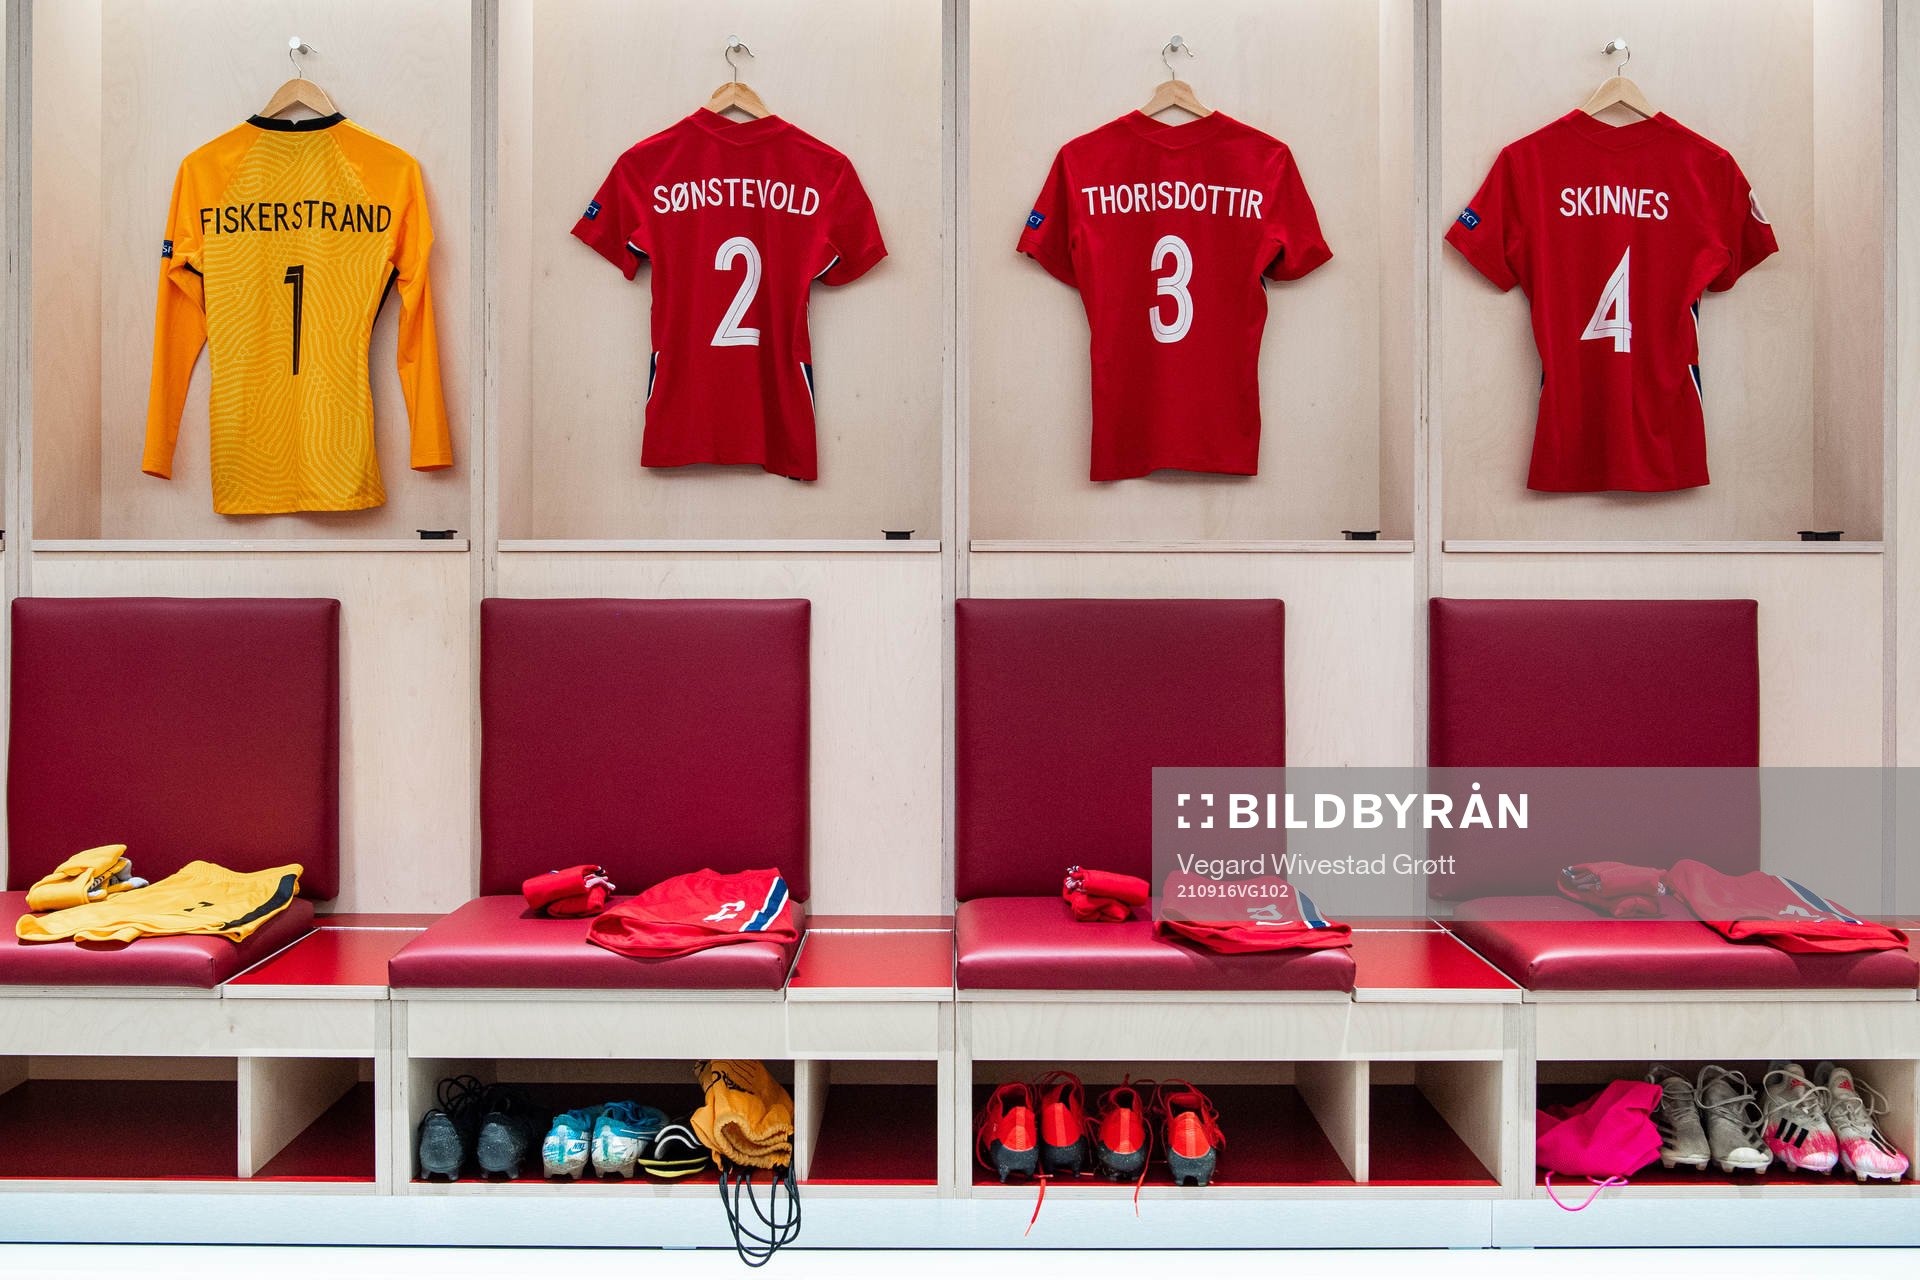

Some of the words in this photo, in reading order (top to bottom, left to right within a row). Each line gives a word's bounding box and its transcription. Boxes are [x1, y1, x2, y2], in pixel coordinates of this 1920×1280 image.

[200, 200, 392, 235] FISKERSTRAND
[653, 178, 820, 216] SØNSTEVOLD
[1081, 181, 1264, 220] THORISDOTTIR
[1559, 185, 1670, 220] SKINNES
[284, 265, 304, 375] 1
[710, 236, 762, 347] 2
[1149, 234, 1194, 344] 3
[1580, 245, 1632, 353] 4
